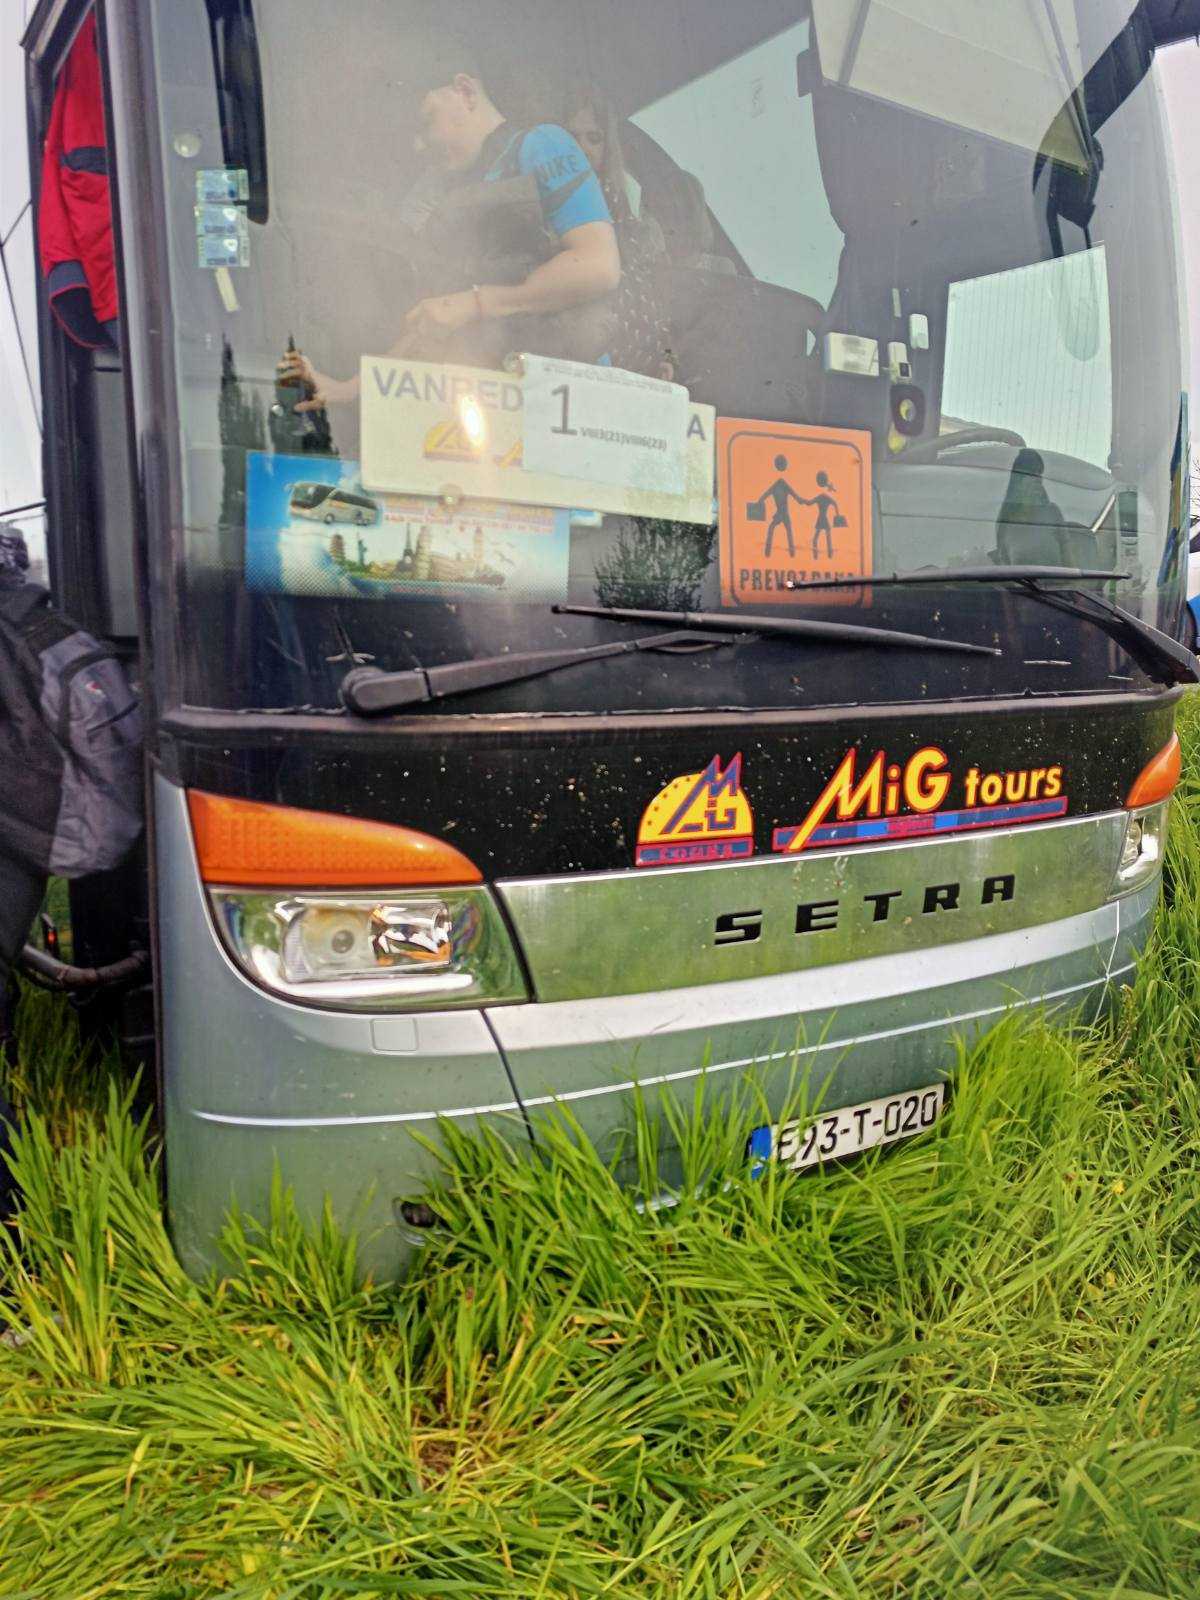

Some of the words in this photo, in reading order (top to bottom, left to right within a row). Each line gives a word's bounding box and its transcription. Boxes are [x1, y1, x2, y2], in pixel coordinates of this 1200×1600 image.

[551, 384, 577, 435] 1
[781, 747, 952, 852] MiG
[964, 765, 1062, 807] tours
[714, 874, 1015, 945] SETRA
